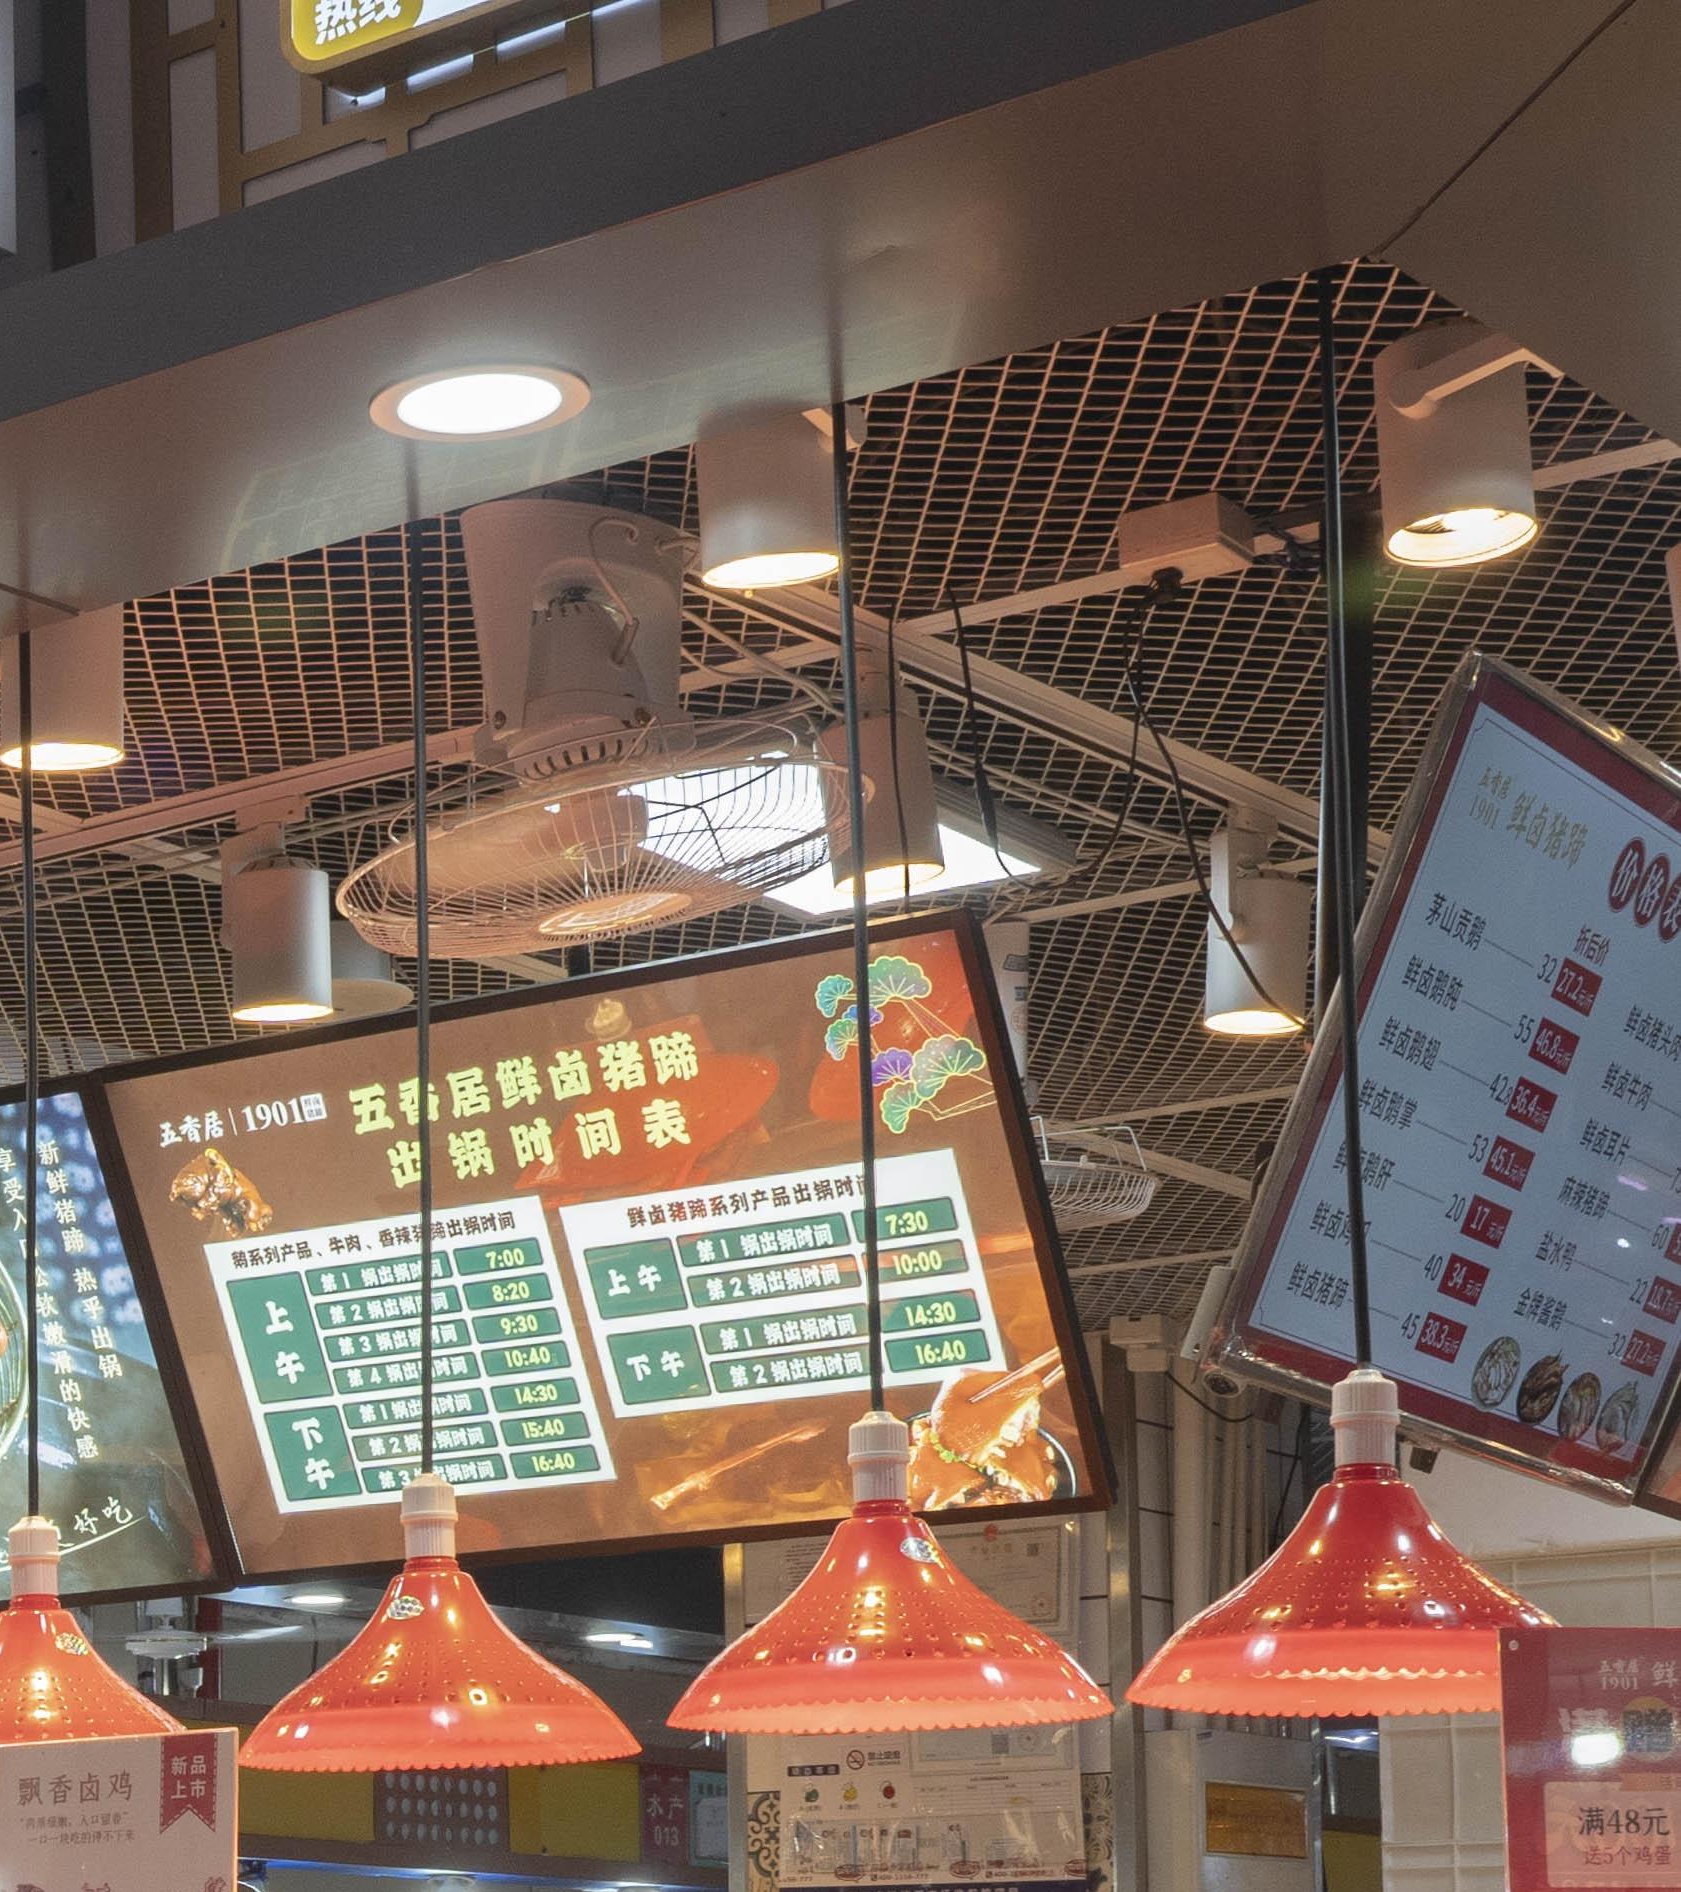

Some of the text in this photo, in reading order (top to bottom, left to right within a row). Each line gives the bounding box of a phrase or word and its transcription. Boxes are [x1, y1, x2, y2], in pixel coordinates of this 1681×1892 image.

[1425, 892, 1487, 952] 茅山贡鹅
[1537, 953, 1558, 984] 32
[1513, 1013, 1535, 1044] 55
[348, 1030, 701, 1136] 五香居鲜卤猪蹄
[1600, 1060, 1654, 1115] 鲜卤牛肉
[159, 1110, 225, 1149] 五香居
[242, 1097, 305, 1133] 1901
[385, 1098, 692, 1189] 出锅时间表
[1468, 1133, 1489, 1164] 53
[1579, 1117, 1632, 1168] 鲜卤耳片
[1445, 1193, 1466, 1223] 20
[695, 1210, 929, 1264] 第1锅出锅时间 7:30
[1651, 1223, 1670, 1251] 60
[38, 1140, 123, 1379] 新鲜猪蹄 热乎出锅
[485, 1248, 526, 1270] 7:00
[1424, 1253, 1444, 1282] 40
[1534, 1230, 1578, 1272] 盐水鸭
[1629, 1277, 1649, 1305] 22
[491, 1281, 531, 1302] 8:20
[607, 1263, 663, 1298] 上午
[705, 1249, 943, 1302] 第2锅出锅时间 10:00
[1287, 1260, 1350, 1313] 鲜卤猪蹄
[1400, 1312, 1421, 1341] 45
[500, 1314, 539, 1335] 9:30
[719, 1300, 957, 1352] 第1锅出锅时间 14:30
[263, 1300, 306, 1385] 上午
[504, 1346, 552, 1368] 10:40
[1607, 1333, 1625, 1360] 32
[625, 1349, 686, 1382] 下午
[728, 1339, 967, 1389] 第2锅出锅时间 16:40
[515, 1382, 559, 1404] 14:30
[291, 1416, 335, 1491] 下午
[369, 1418, 565, 1457] 第2锅锅时间 15:40
[531, 1452, 576, 1473] 16:40
[1600, 1676, 1640, 1690] 1901
[169, 1754, 208, 1777] 新品
[16, 1768, 134, 1808] 飘香卤鸡
[170, 1778, 208, 1801] 上市
[646, 1792, 685, 1820] 水产
[1578, 1806, 1671, 1837] 满48元
[653, 1825, 680, 1847] 013
[1584, 1845, 1672, 1867] 送5个鸡蛋
